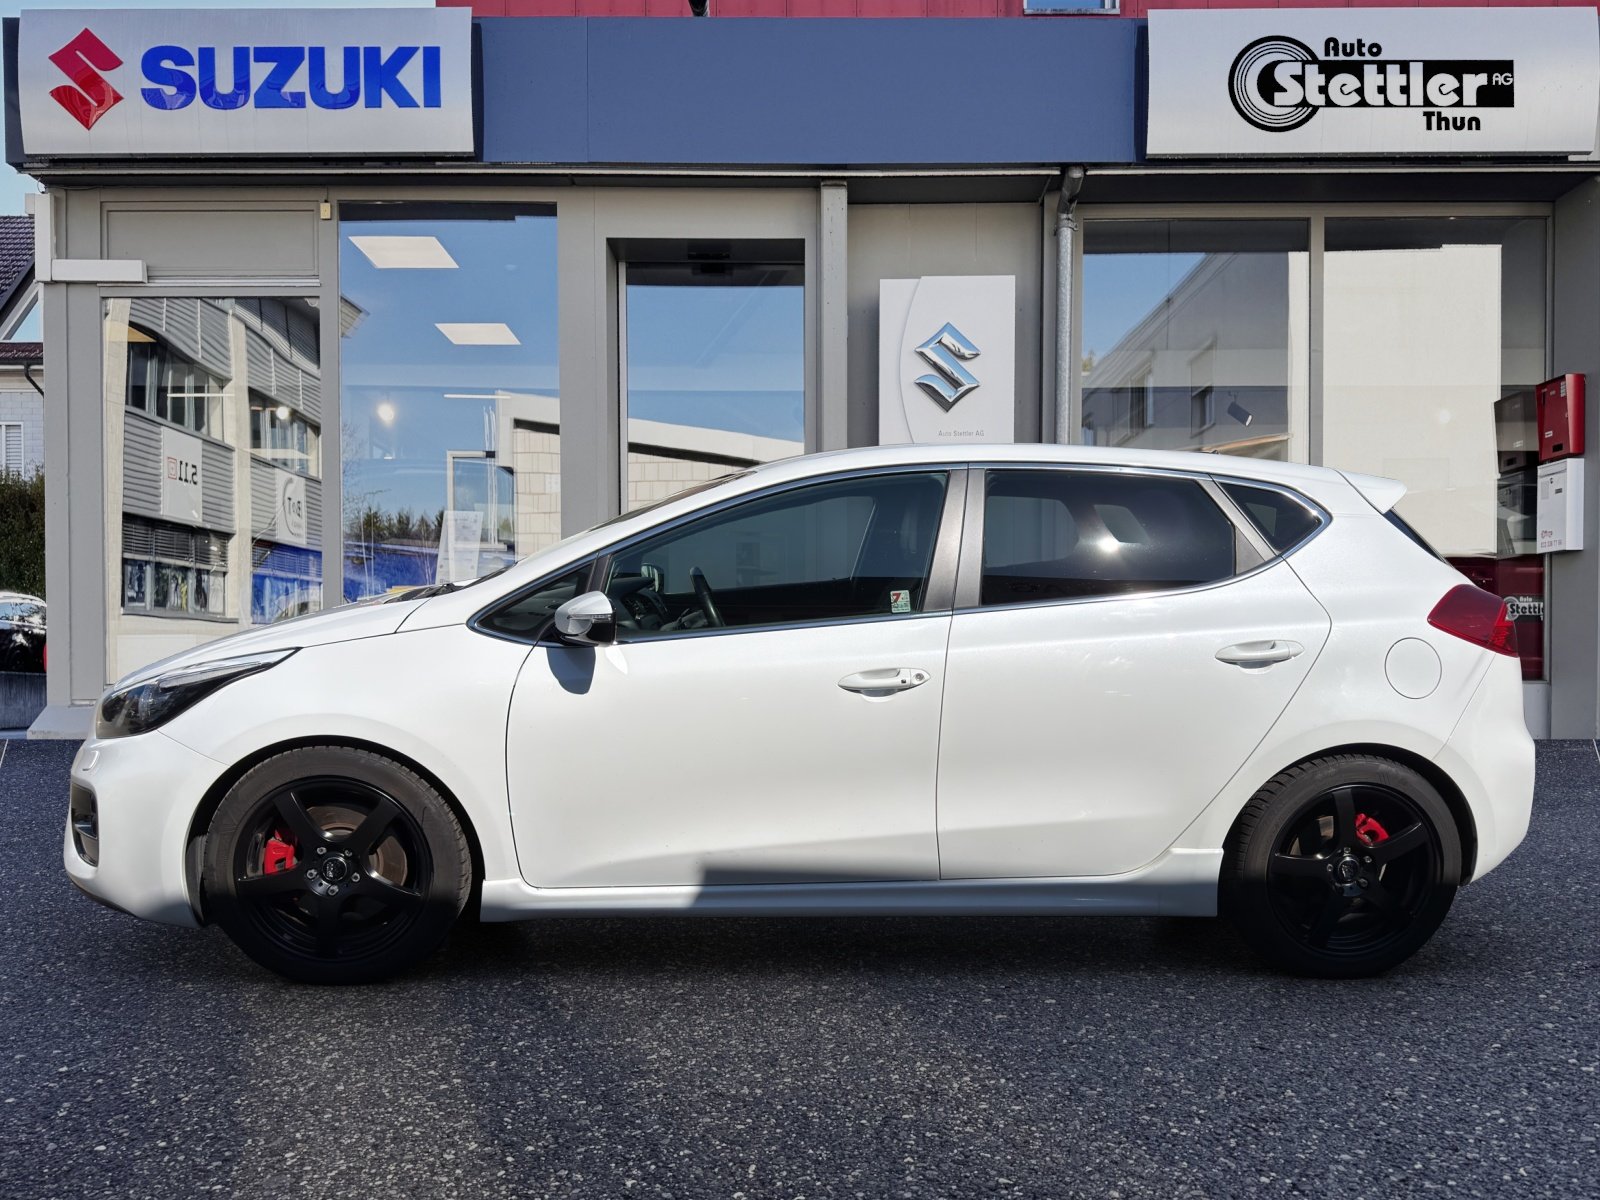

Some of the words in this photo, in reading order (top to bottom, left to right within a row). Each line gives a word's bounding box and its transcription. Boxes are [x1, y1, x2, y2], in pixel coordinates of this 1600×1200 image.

[1324, 36, 1383, 57] Auto
[140, 45, 441, 110] SUZUKI
[1273, 61, 1488, 107] Stettler
[1492, 72, 1513, 86] AG
[1422, 110, 1481, 131] Thun
[975, 429, 985, 437] AG
